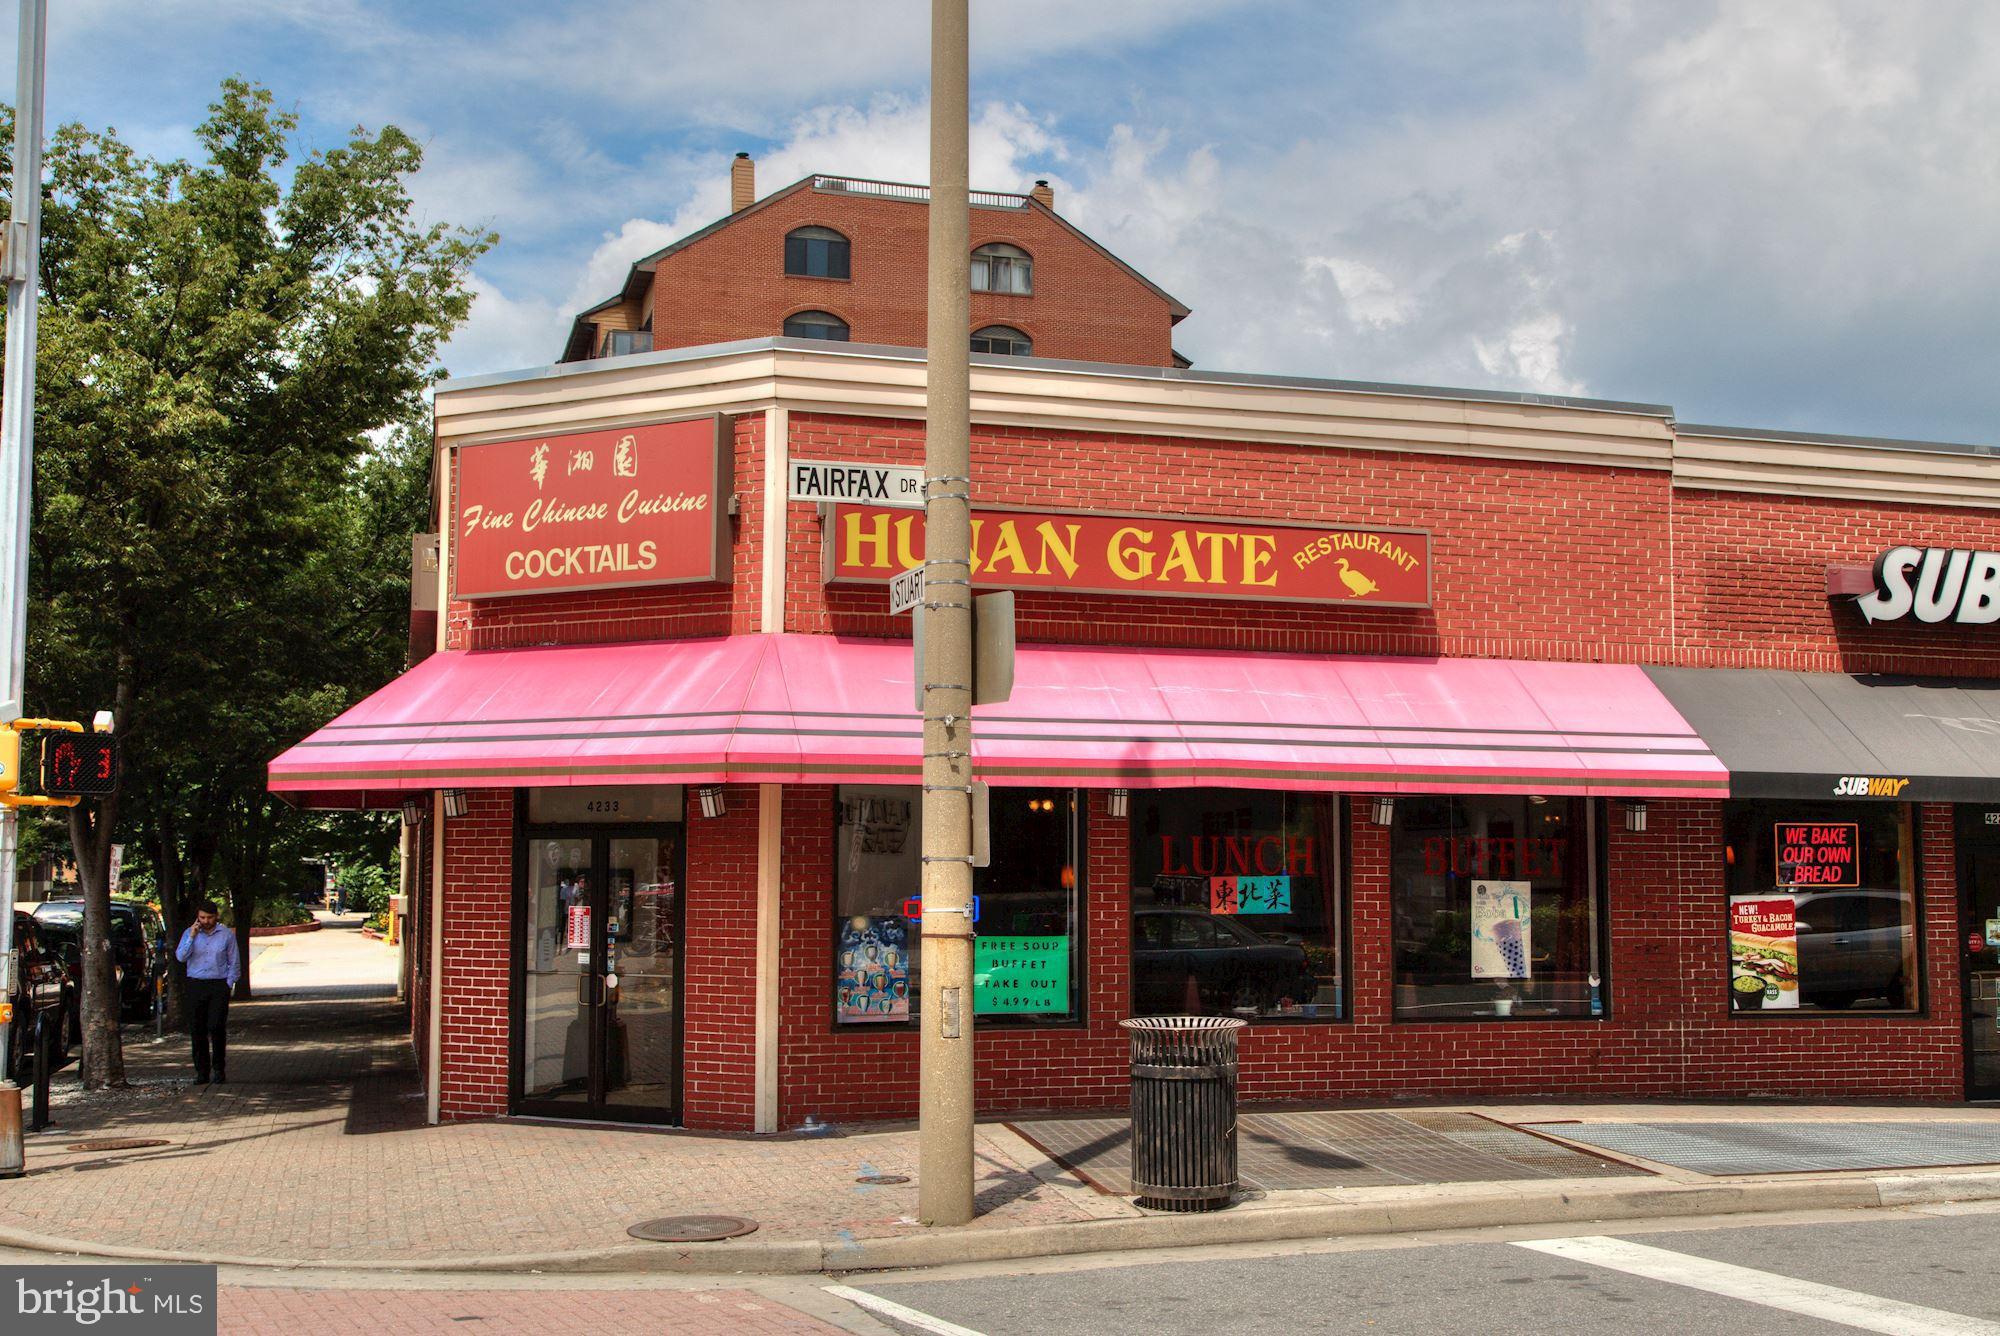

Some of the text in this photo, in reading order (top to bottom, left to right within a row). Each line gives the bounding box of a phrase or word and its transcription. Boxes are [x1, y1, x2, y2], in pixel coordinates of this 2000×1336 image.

[796, 467, 917, 499] FAIRFAX DR
[463, 488, 707, 537] Fine Chinese Cuisine
[505, 540, 657, 581] COCKTAILS
[1106, 526, 1279, 588] GATE
[1292, 532, 1420, 574] RESTAURANT
[895, 570, 924, 608] STUART
[1855, 546, 2000, 624] SUB
[1833, 776, 1910, 796] SUBWAY
[587, 801, 619, 812] 4233
[1785, 827, 1848, 844] WE BAKE
[1159, 833, 1316, 876] LUNCH
[1423, 836, 1568, 877] BUFFET
[1783, 847, 1852, 863] OUR OWN
[1794, 865, 1843, 883] BREAD
[1738, 905, 1759, 915] NEW!
[1769, 913, 1793, 923] BACON
[981, 941, 1059, 951] FREE SOUP
[992, 959, 1047, 969] BUFFET
[984, 979, 1057, 988] TAKE OUT
